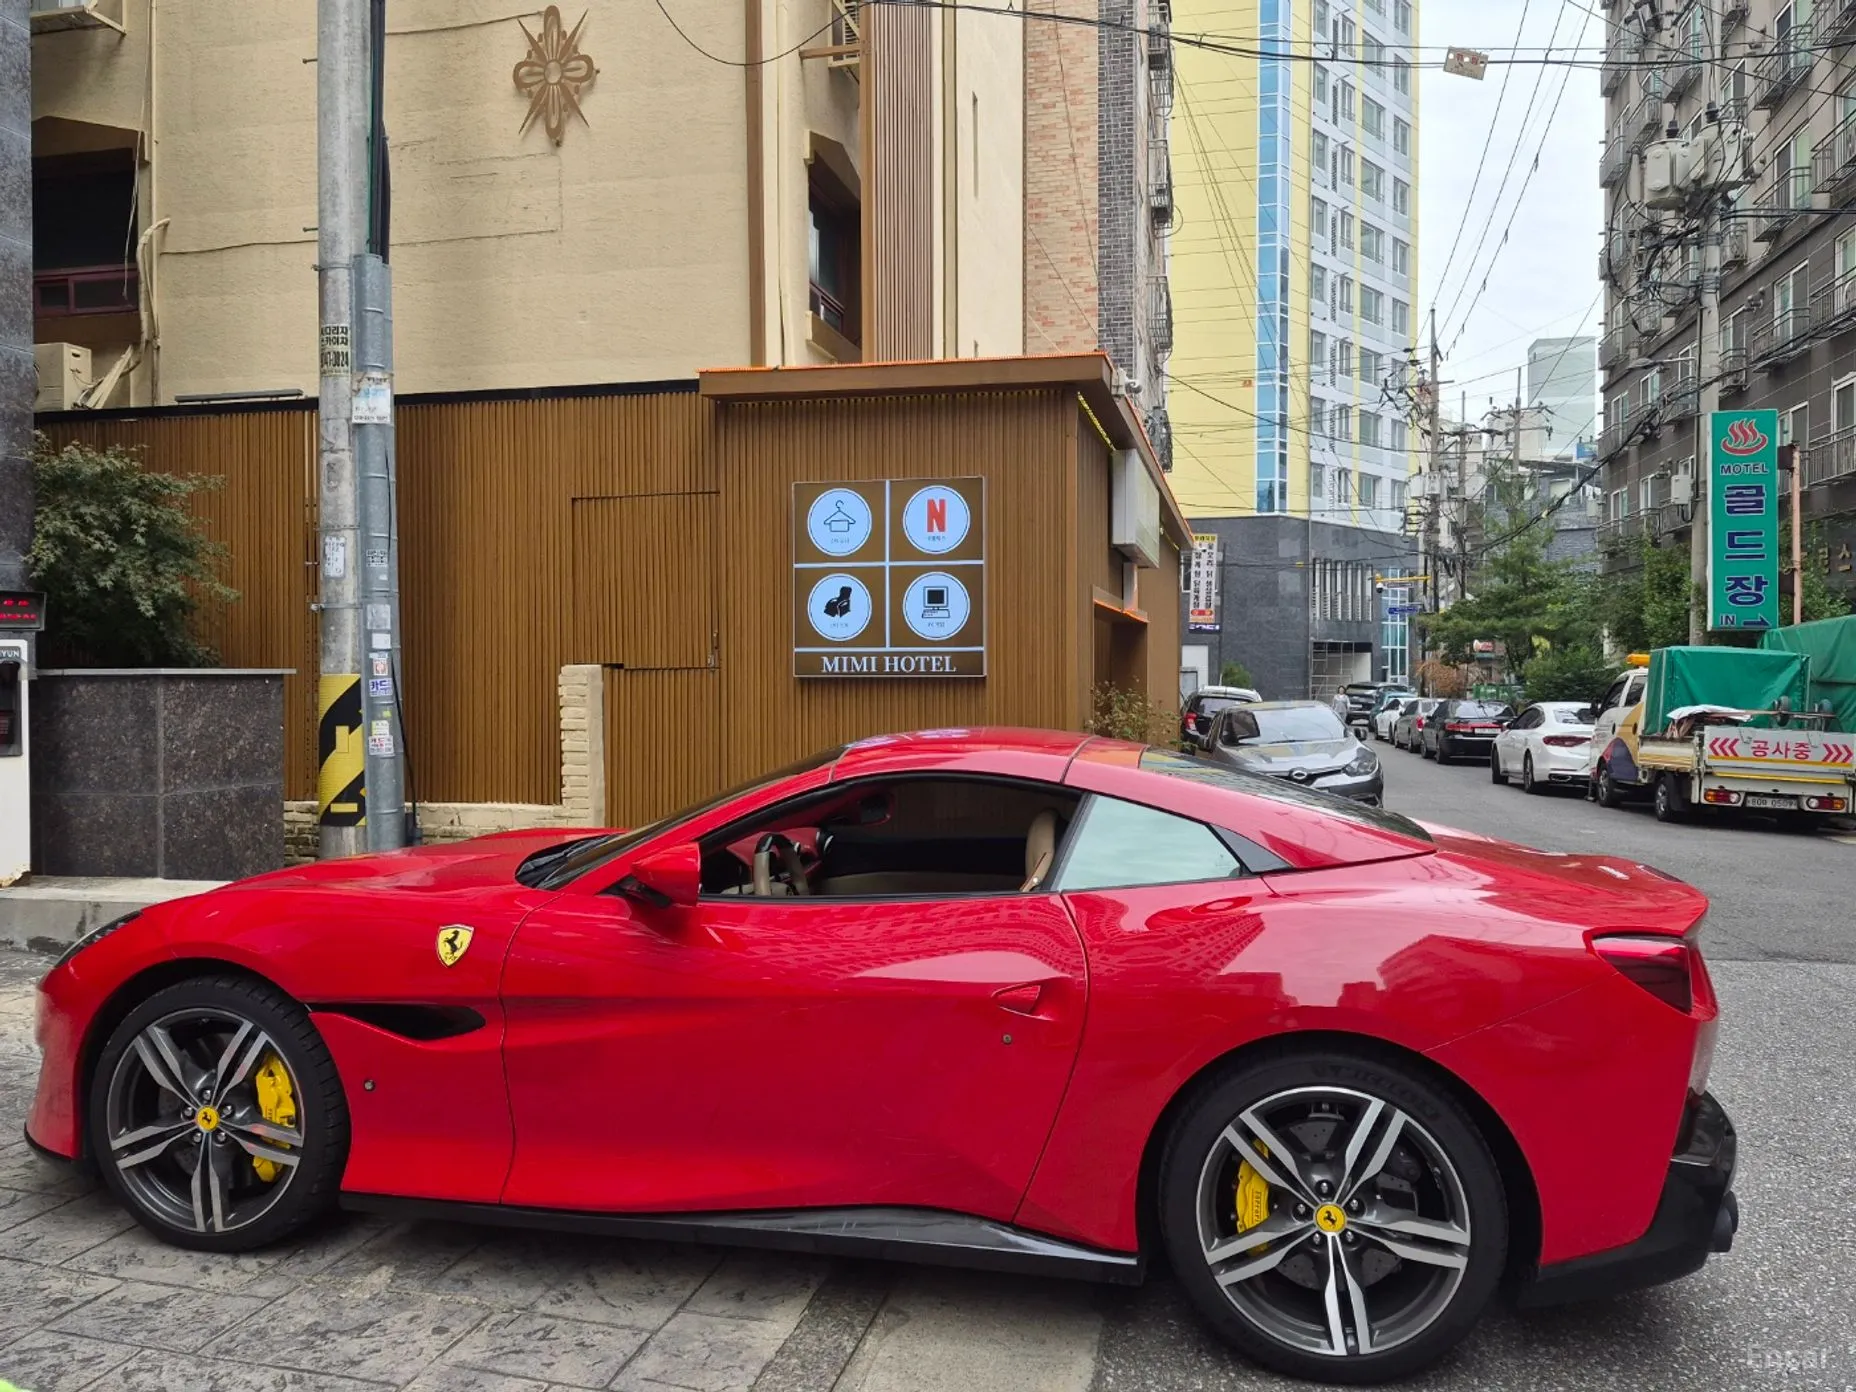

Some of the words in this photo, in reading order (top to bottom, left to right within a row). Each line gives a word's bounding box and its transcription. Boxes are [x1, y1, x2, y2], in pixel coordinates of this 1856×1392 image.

[1720, 463, 1769, 475] MOTEL
[1724, 484, 1768, 606] 골드장
[1720, 614, 1736, 626] IN
[0, 649, 20, 658] YUN
[821, 656, 878, 673] MIMI
[883, 656, 957, 673] HOTEL
[370, 680, 388, 691] 카드
[1751, 739, 1811, 760] 공사중
